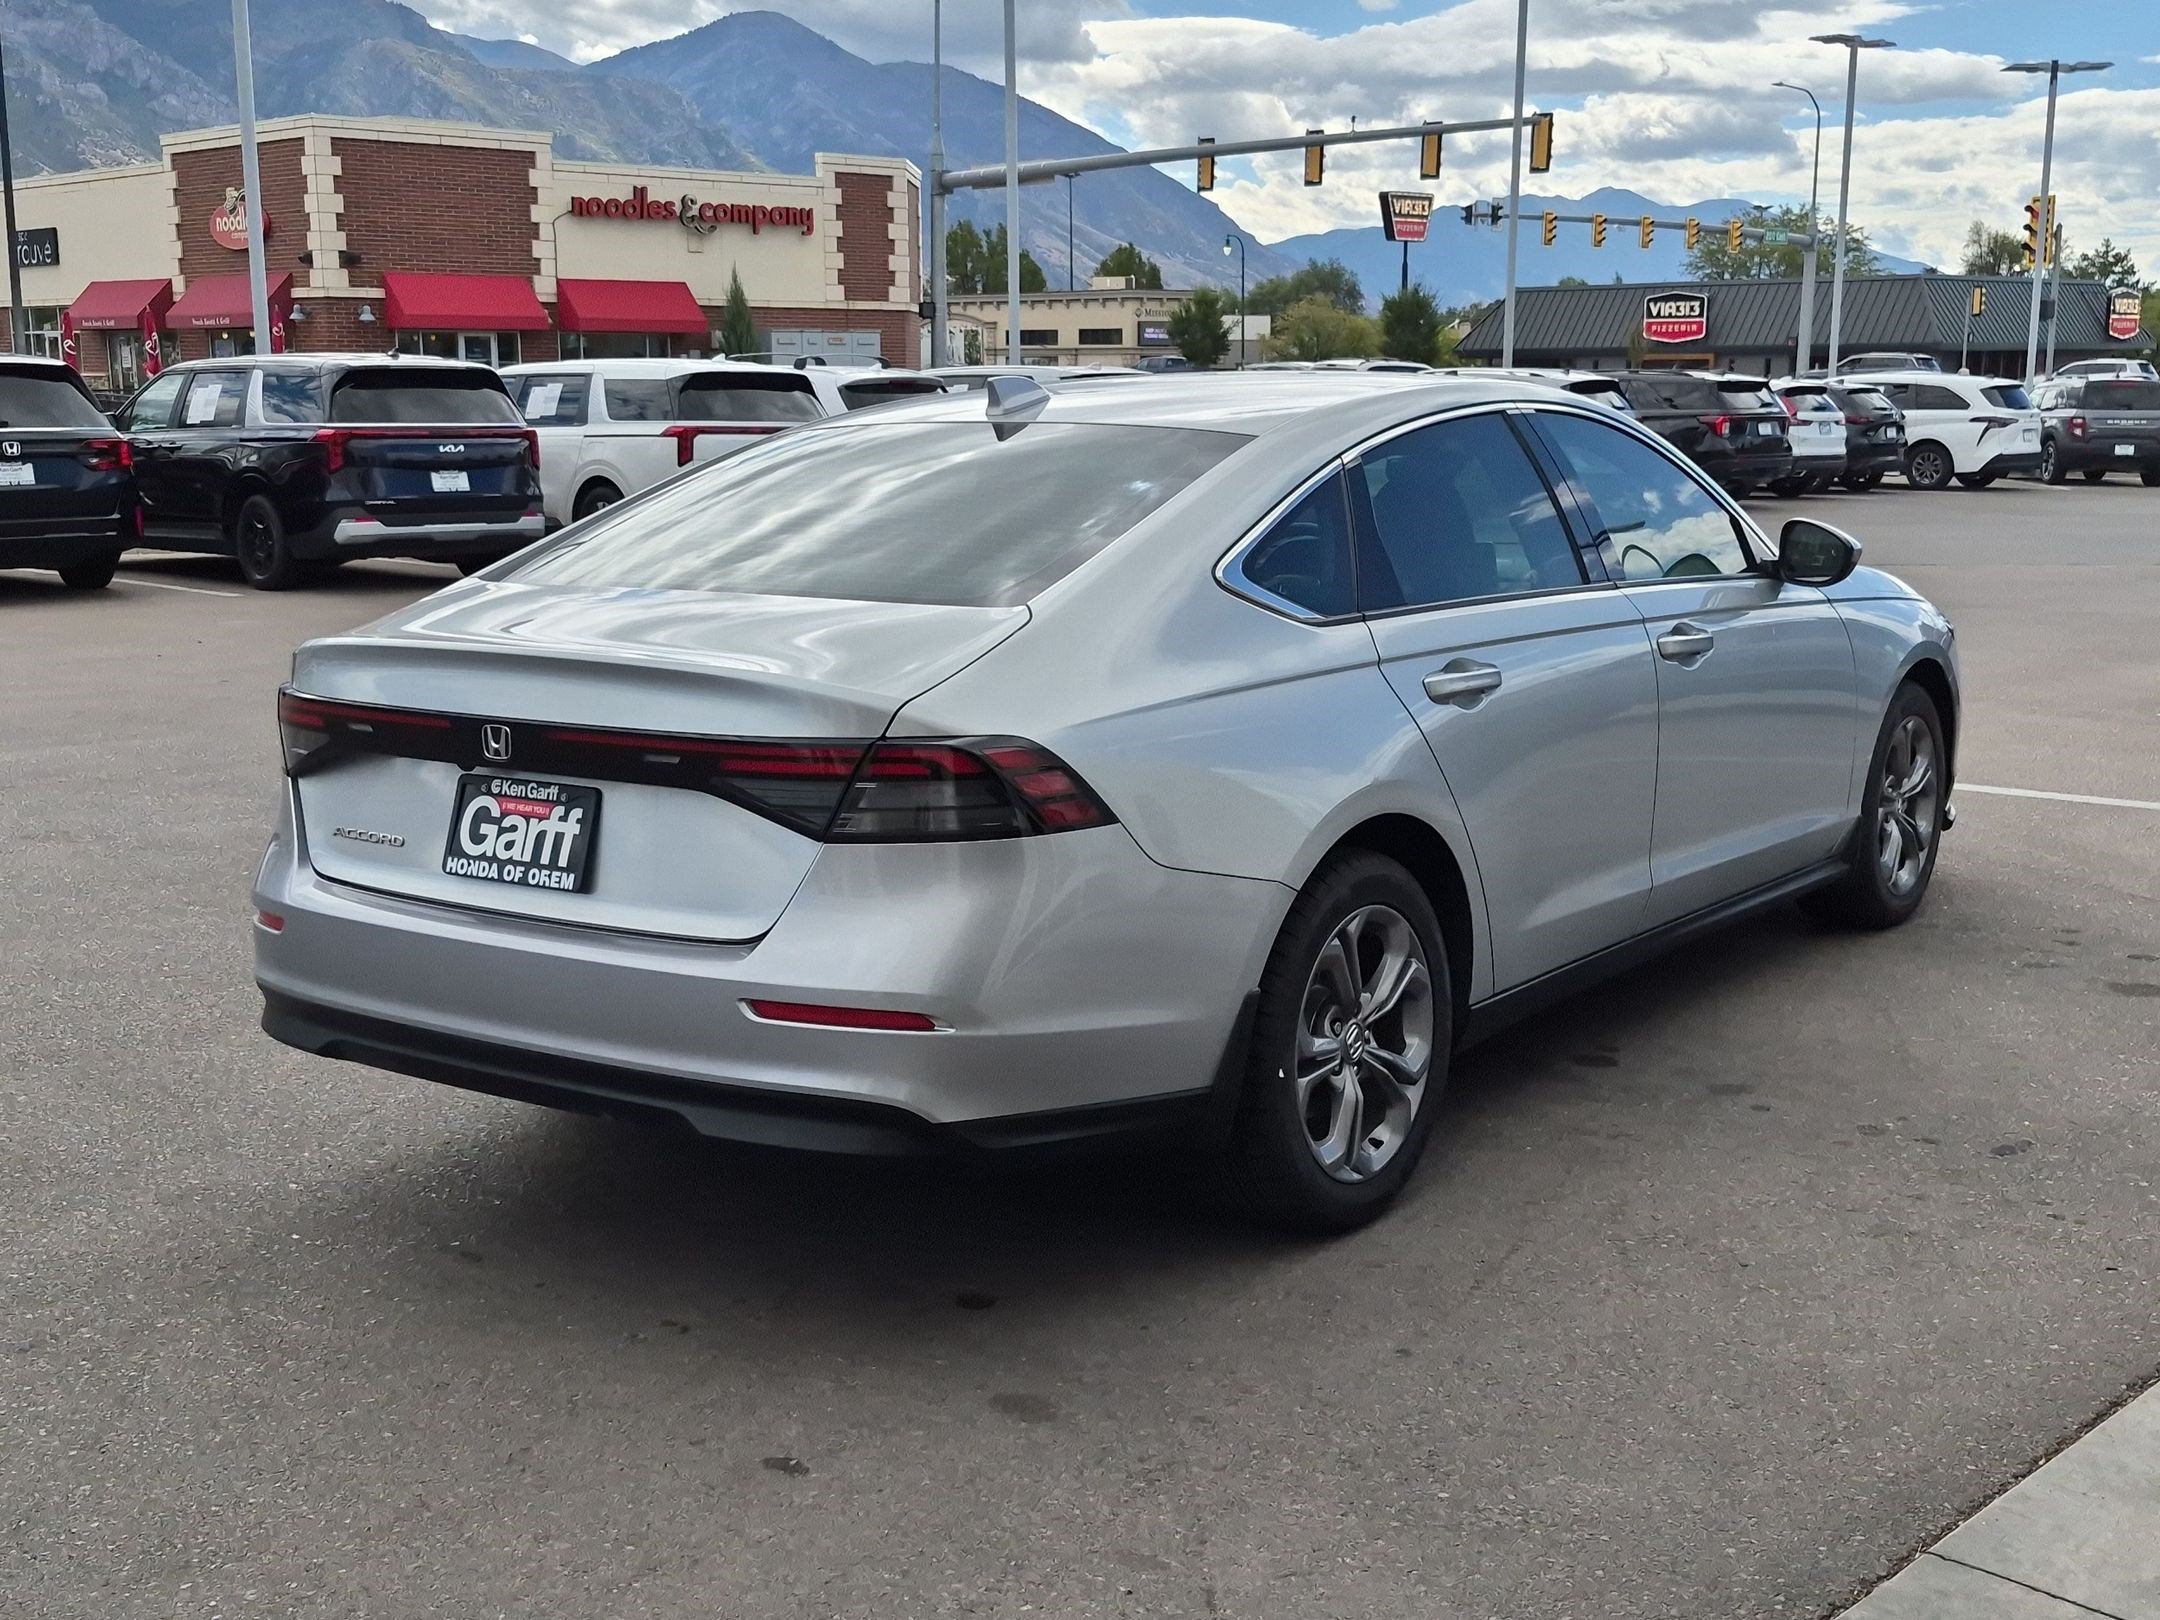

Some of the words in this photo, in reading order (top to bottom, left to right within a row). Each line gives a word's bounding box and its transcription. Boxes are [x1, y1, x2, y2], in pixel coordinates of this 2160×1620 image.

[215, 205, 247, 232] noodl
[571, 185, 677, 222] noodles
[679, 193, 718, 235] &
[699, 201, 814, 236] company
[502, 780, 526, 798] Ken
[527, 783, 559, 801] Garff
[517, 803, 533, 812] HEAR
[533, 806, 546, 814] YOU
[333, 827, 406, 848] ACCORD
[460, 795, 584, 868] Garff
[446, 857, 499, 880] HONDA
[503, 864, 525, 883] OF
[527, 868, 575, 890] OREM
